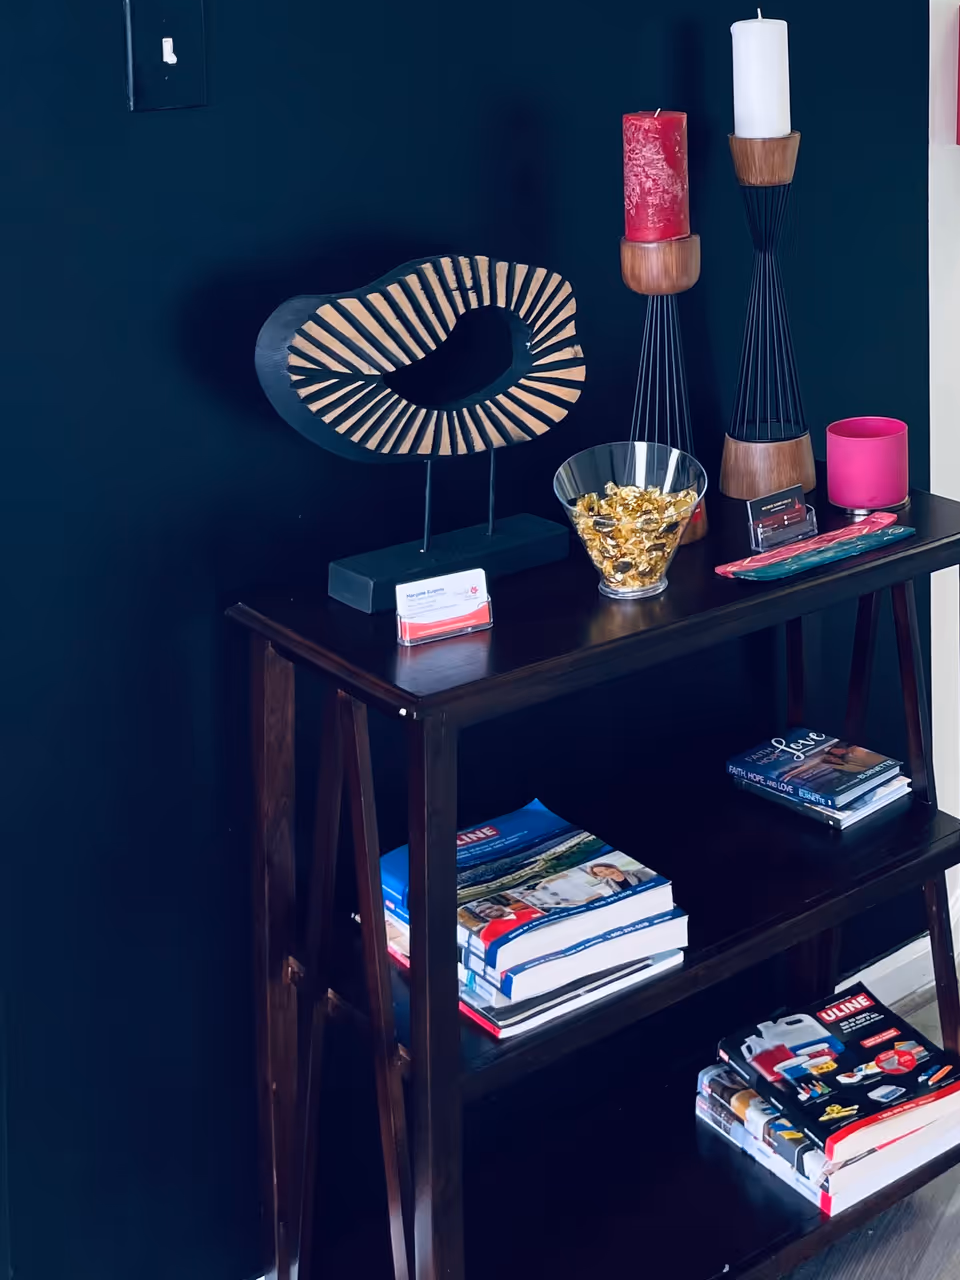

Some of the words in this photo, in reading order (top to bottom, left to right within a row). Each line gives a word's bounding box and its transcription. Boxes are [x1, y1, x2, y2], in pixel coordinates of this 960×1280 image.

[771, 732, 826, 761] Love
[858, 759, 896, 780] BURNETTE
[777, 781, 794, 794] LOVE
[457, 826, 497, 845] LINE
[820, 995, 871, 1021] ULINE
